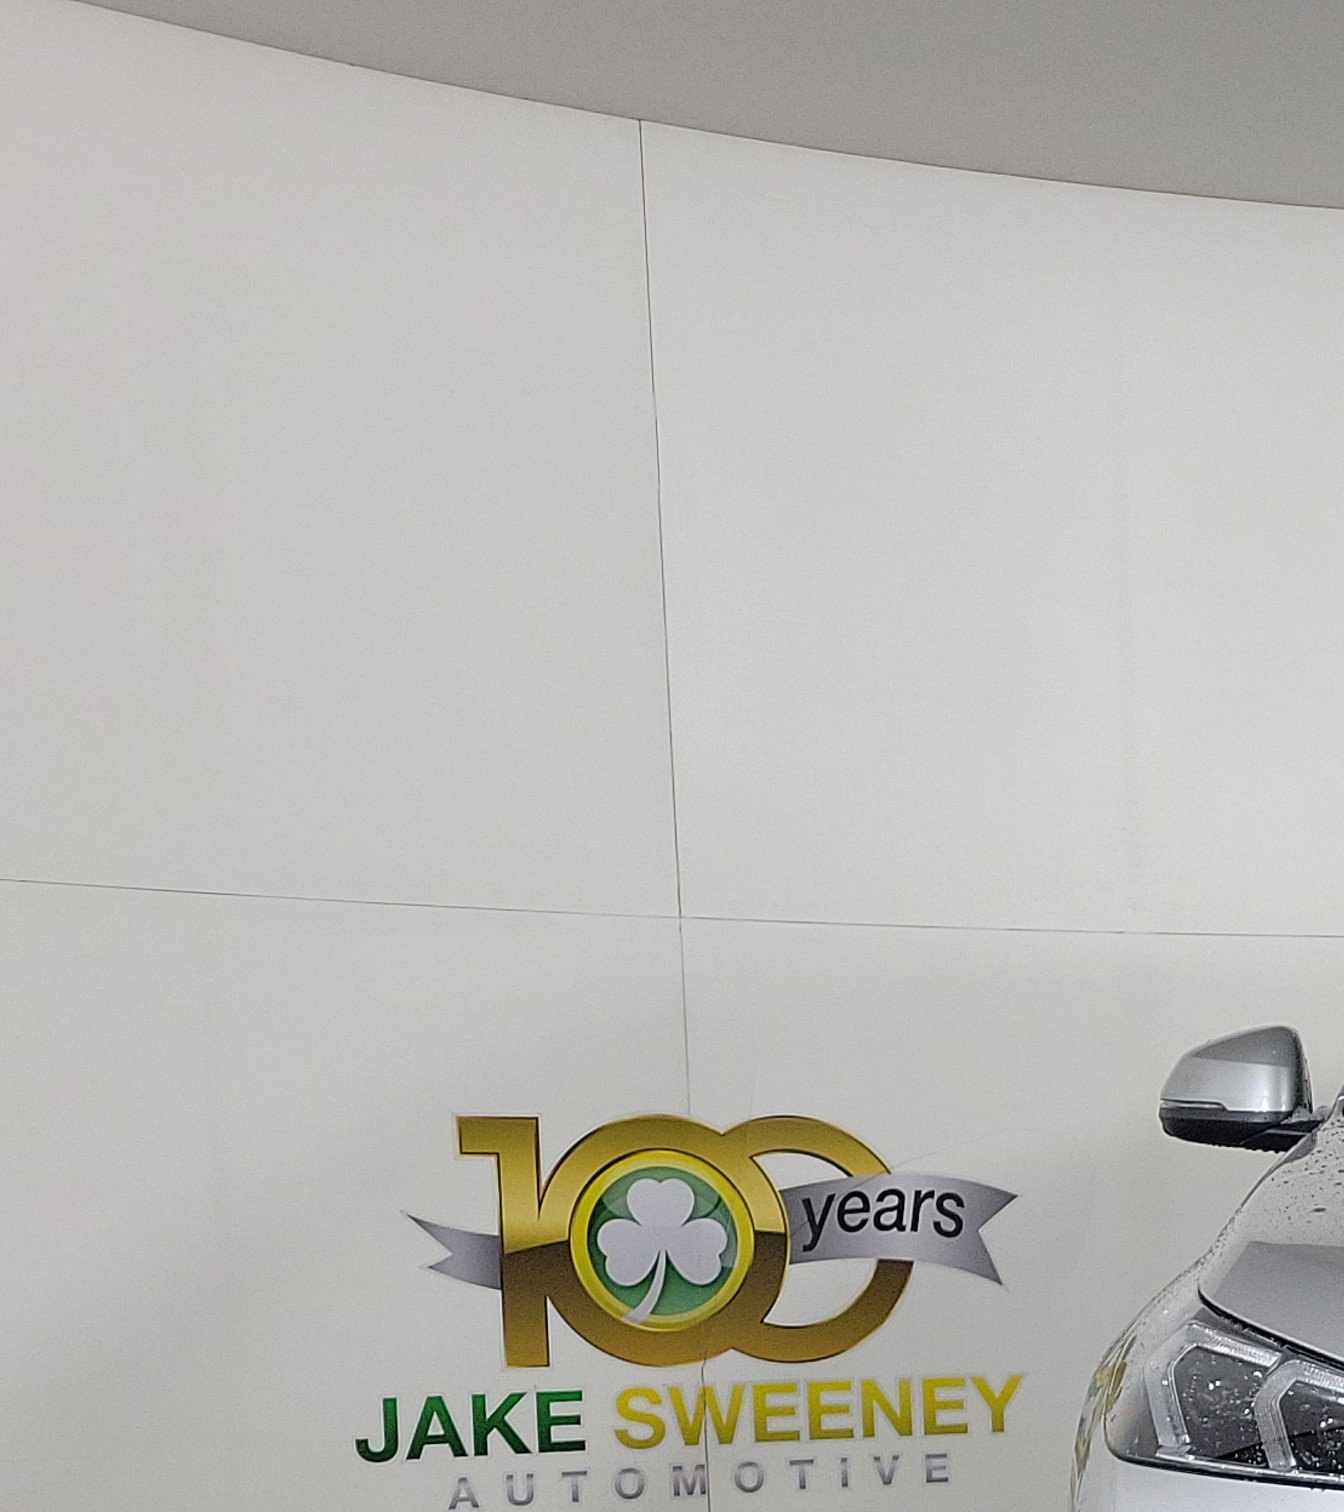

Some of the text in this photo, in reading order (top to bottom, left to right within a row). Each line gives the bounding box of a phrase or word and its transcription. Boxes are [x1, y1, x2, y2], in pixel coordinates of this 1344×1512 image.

[455, 1113, 966, 1368] 100 years
[355, 1374, 1023, 1463] JAKE SWEENEY
[448, 1453, 950, 1511] AUTOMOTIVE
